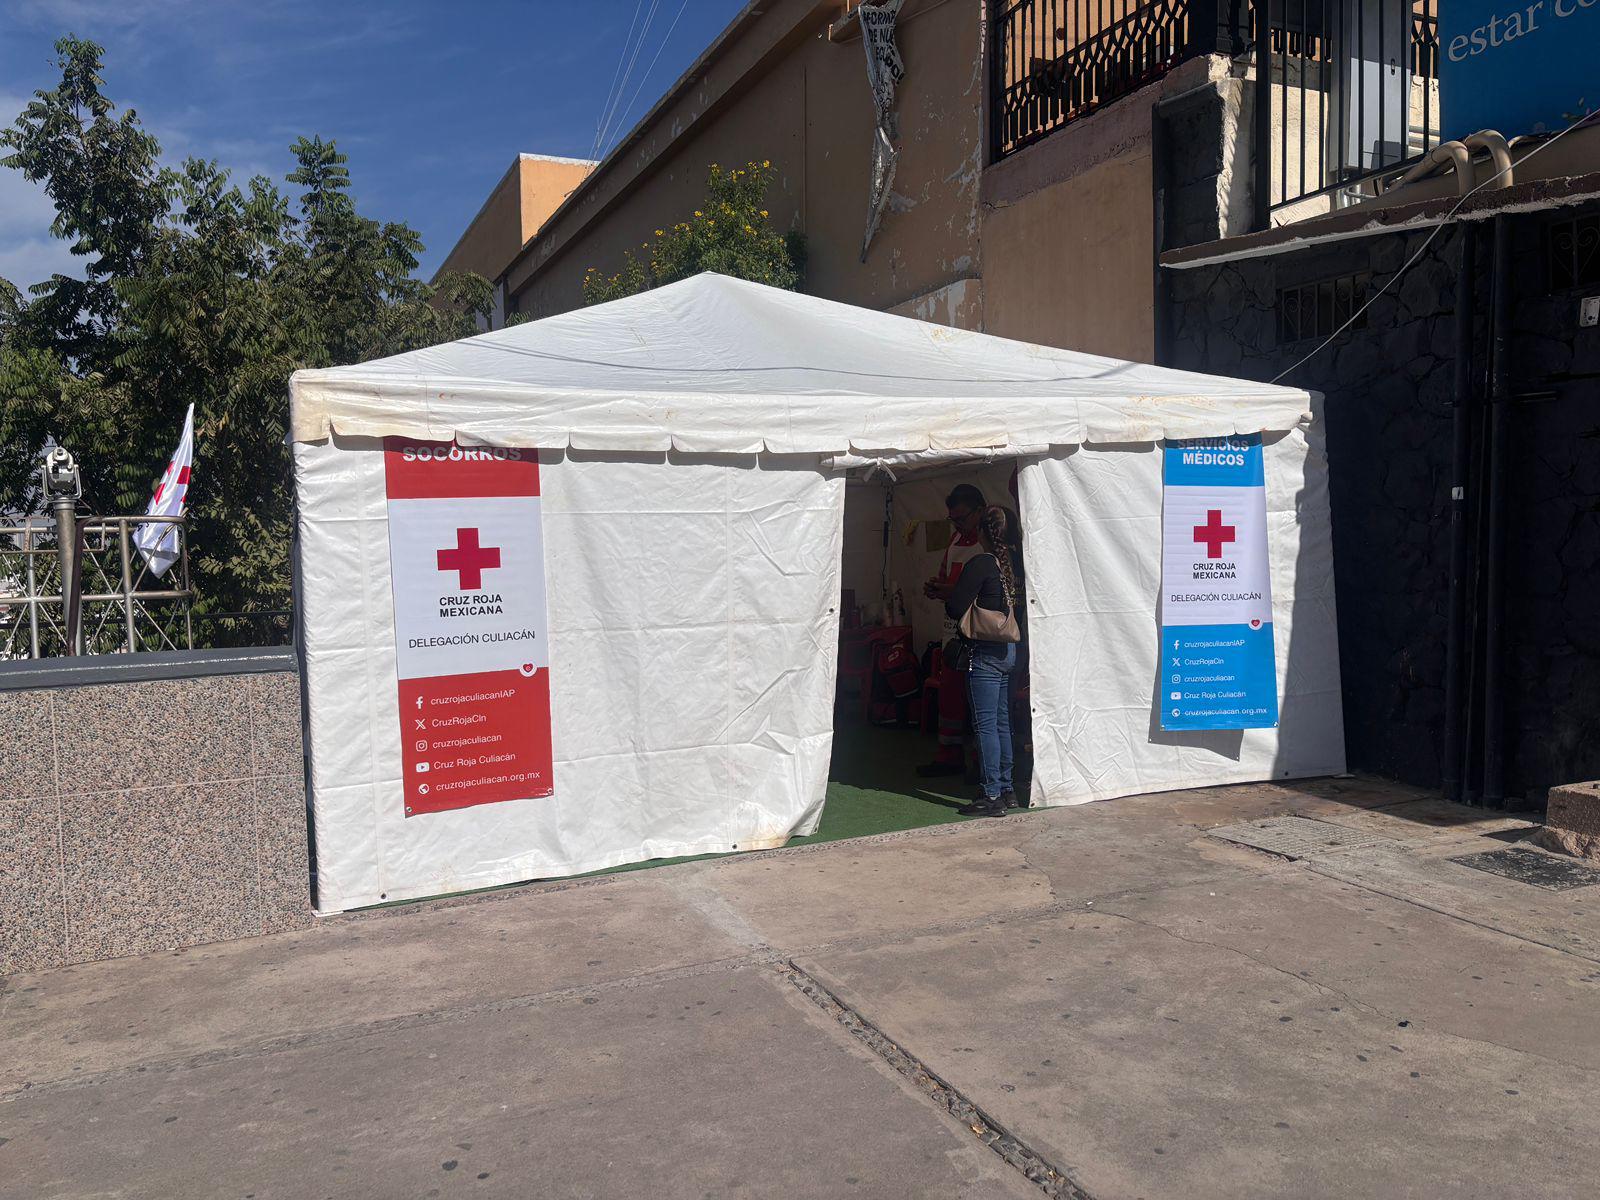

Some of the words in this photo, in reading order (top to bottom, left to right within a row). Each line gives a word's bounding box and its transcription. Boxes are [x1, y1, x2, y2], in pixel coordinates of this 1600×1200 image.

[1448, 1, 1544, 62] estar
[1177, 438, 1250, 452] SERVICIOS
[402, 446, 522, 462] SOCORROS
[1182, 451, 1245, 466] MÉDICOS
[1193, 563, 1214, 571] CRUZ
[1215, 562, 1237, 571] ROJA
[1193, 571, 1237, 579] MEXICANA
[439, 595, 470, 607] CRUZ
[473, 594, 503, 604] ROJA
[1171, 592, 1220, 602] DELEGACIÓN
[1221, 592, 1262, 601] CULIACÁN
[439, 605, 503, 618] MEXICANA
[408, 633, 479, 649] DELEGACIÓN
[481, 629, 536, 644] CULIACÁN
[430, 688, 516, 706] cruzrojaculiacanIAP
[1201, 691, 1216, 700] Roja
[432, 733, 502, 750] cruzrojaculiacan
[433, 760, 454, 770] Cruz
[457, 757, 477, 768] Roja
[478, 752, 516, 764] Culiacán
[436, 771, 541, 792] cruzrojaculiacan.org.mx
